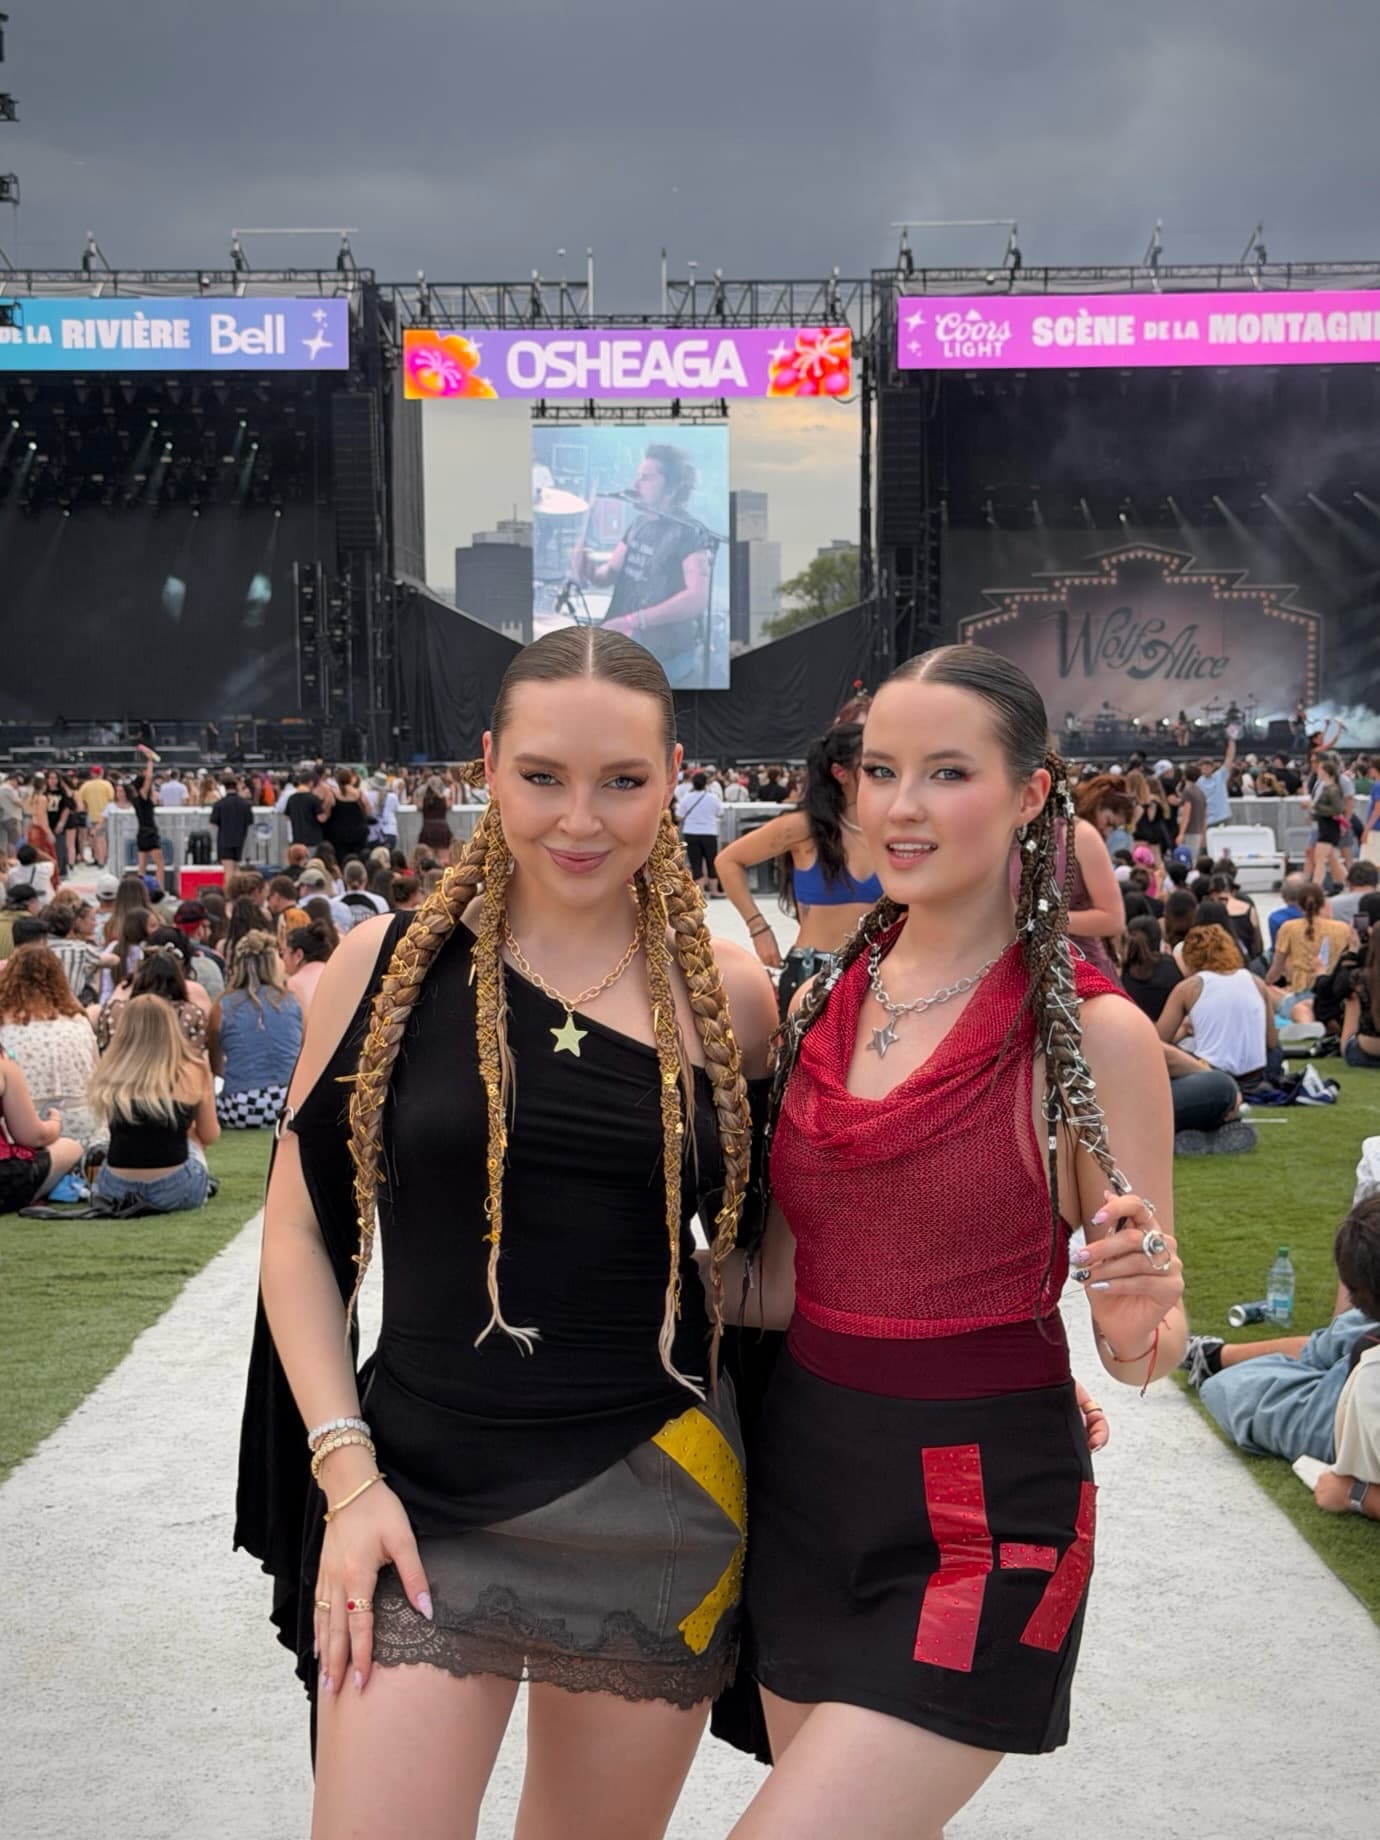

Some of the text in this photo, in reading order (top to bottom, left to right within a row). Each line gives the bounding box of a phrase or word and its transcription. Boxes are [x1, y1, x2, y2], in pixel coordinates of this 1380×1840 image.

[26, 325, 52, 344] LA
[61, 311, 191, 349] RIVIÈRE
[210, 313, 285, 355] Bell
[935, 311, 1012, 342] Coors
[1032, 308, 1135, 346] SCÈNE
[1144, 321, 1169, 340] DE
[1173, 320, 1199, 340] LA
[506, 339, 748, 389] OSHEAGA
[943, 341, 1003, 358] LIGHT
[1042, 606, 1230, 680] Wolf Alice
